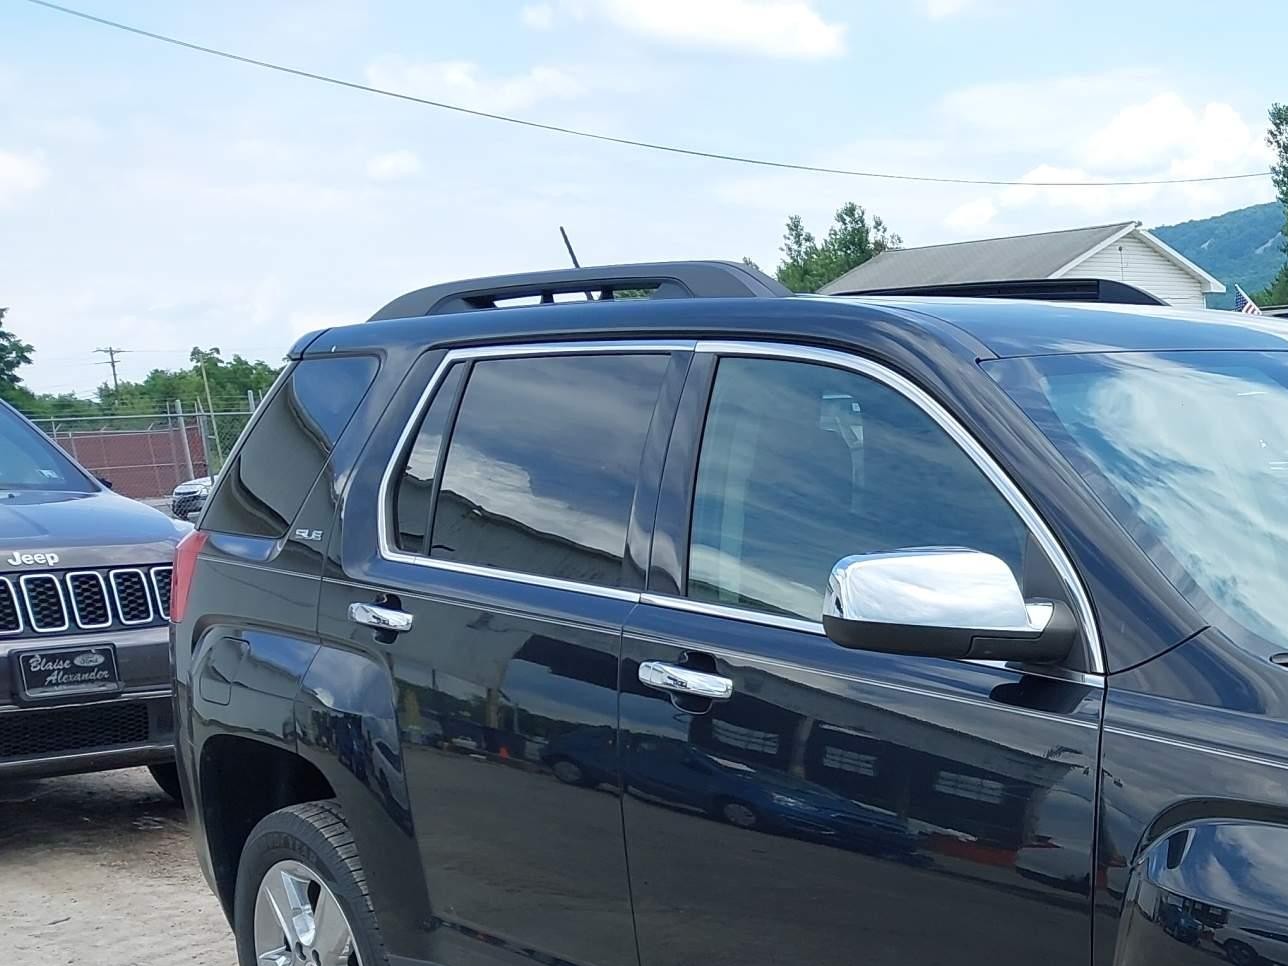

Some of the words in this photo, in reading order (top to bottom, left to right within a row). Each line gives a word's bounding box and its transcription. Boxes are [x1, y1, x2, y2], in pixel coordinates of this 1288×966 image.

[7, 551, 60, 567] Jeep
[28, 655, 72, 672] Blaise
[44, 668, 110, 686] Alexander
